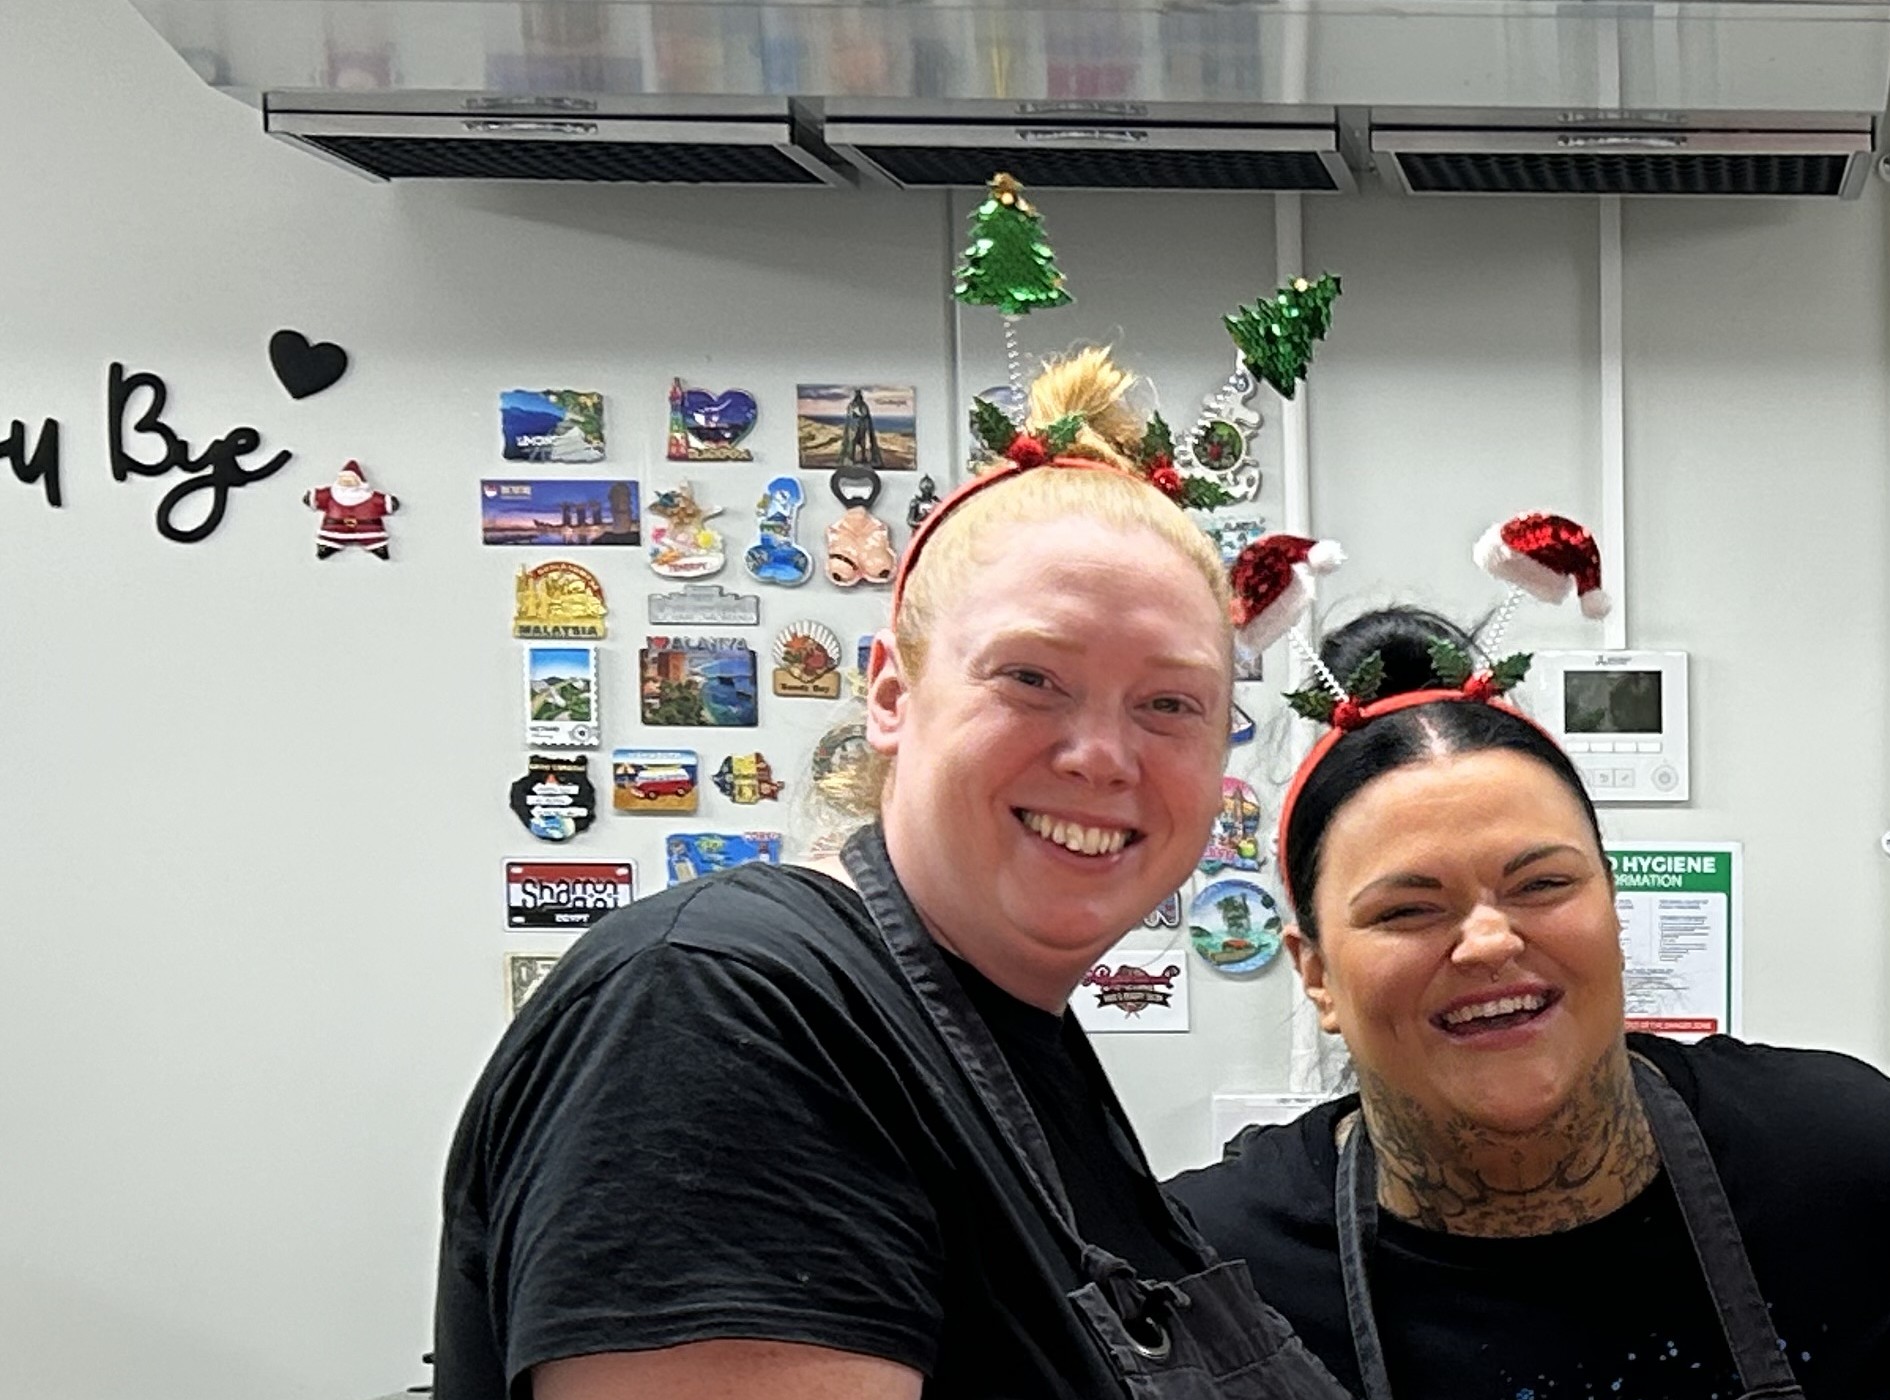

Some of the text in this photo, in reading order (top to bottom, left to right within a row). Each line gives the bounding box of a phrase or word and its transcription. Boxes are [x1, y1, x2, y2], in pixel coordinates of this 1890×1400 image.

[108, 361, 292, 543] Bye
[519, 625, 598, 637] MALAYSIA
[1622, 856, 1717, 873] HYGIENE
[1614, 873, 1683, 888] ORMATION
